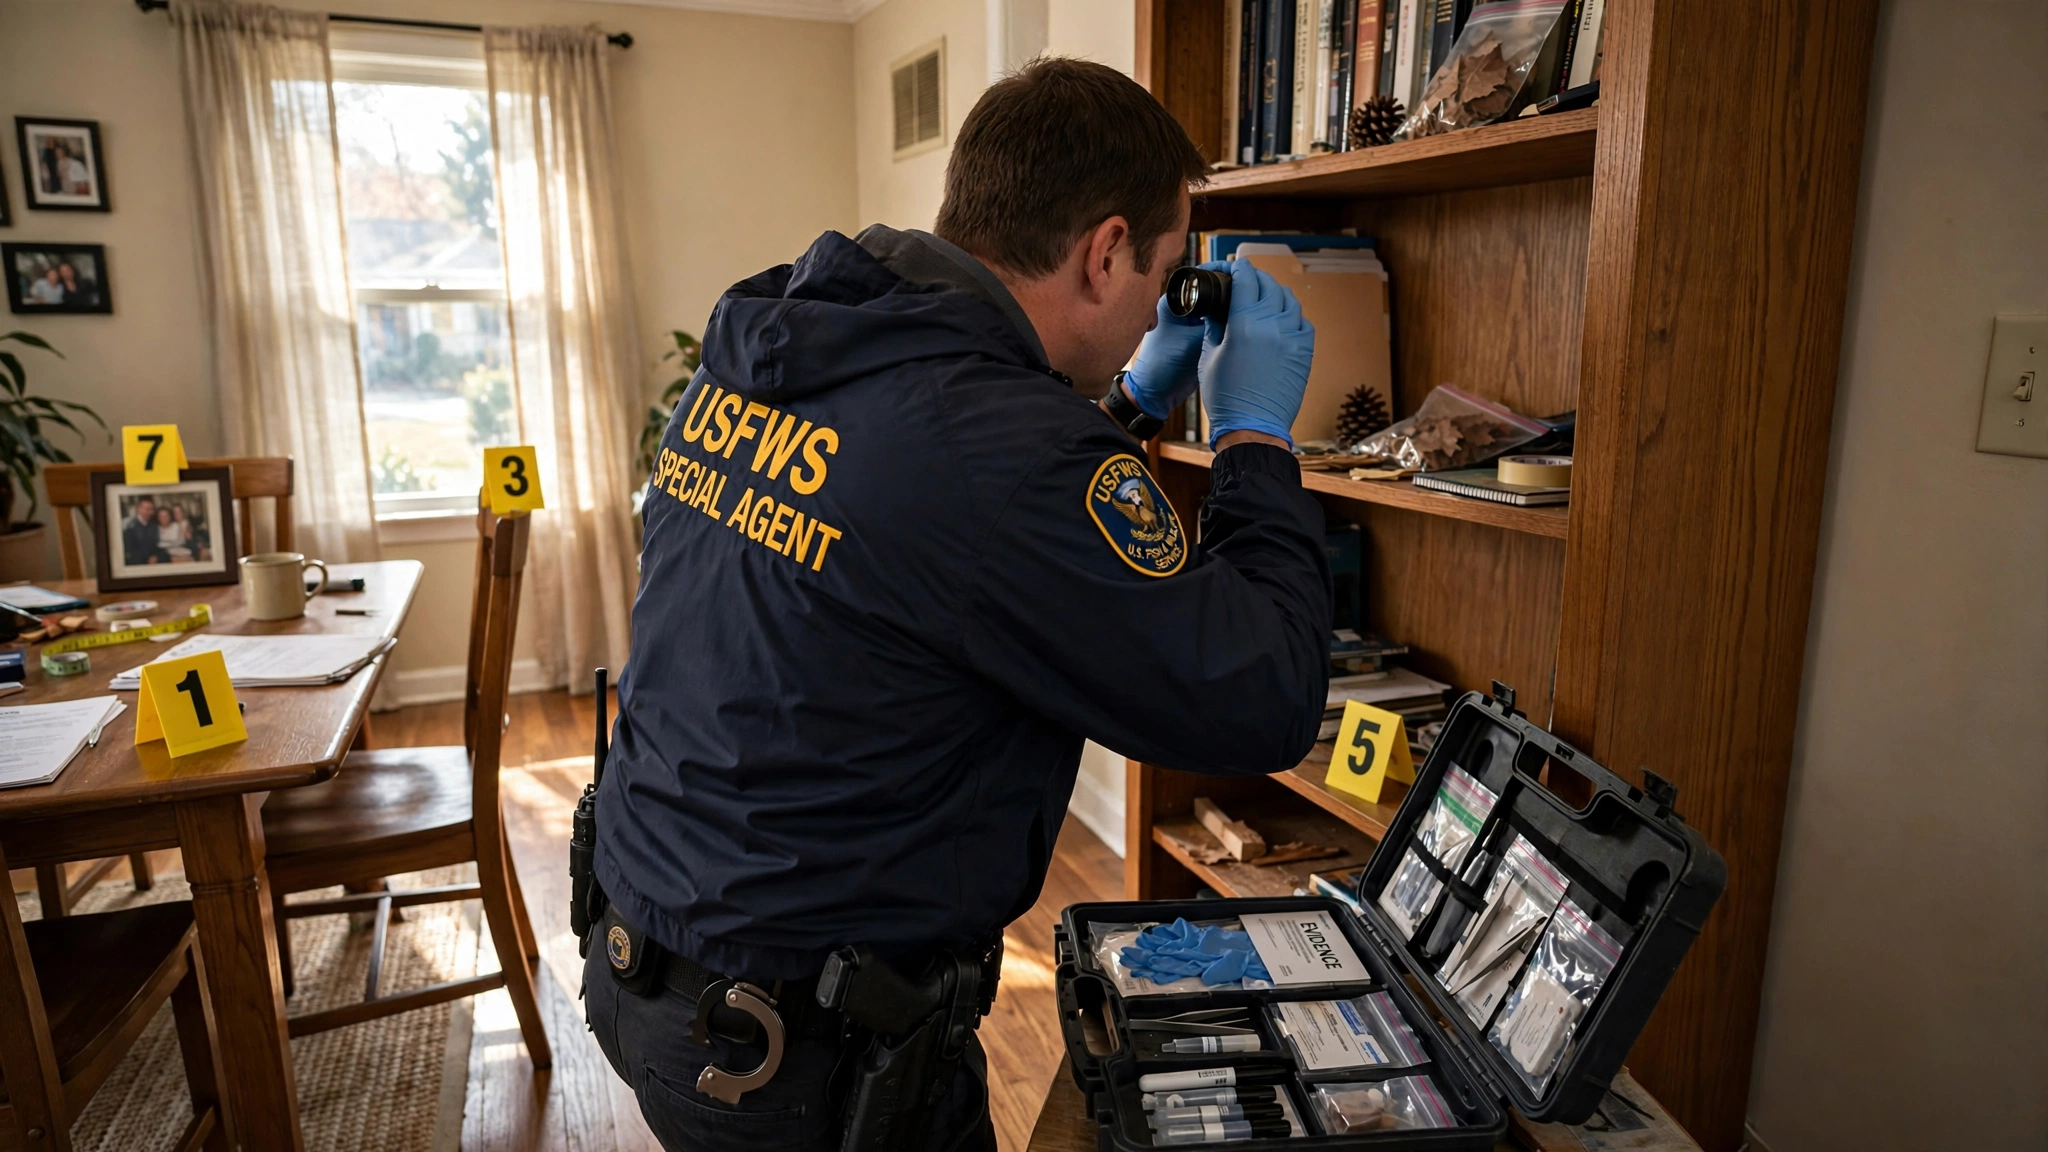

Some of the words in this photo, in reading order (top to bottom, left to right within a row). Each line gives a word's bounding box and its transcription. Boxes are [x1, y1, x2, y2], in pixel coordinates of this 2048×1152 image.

[137, 434, 164, 471] 7
[682, 383, 840, 495] USFWS
[501, 455, 529, 497] 3
[1095, 461, 1142, 503] USFWS
[653, 447, 728, 521] SPECIAL
[725, 487, 843, 572] AGENT
[1127, 543, 1145, 560] U.S.
[175, 669, 214, 728] 1
[1347, 718, 1381, 776] 5
[1300, 922, 1343, 970] EVIDENCE
